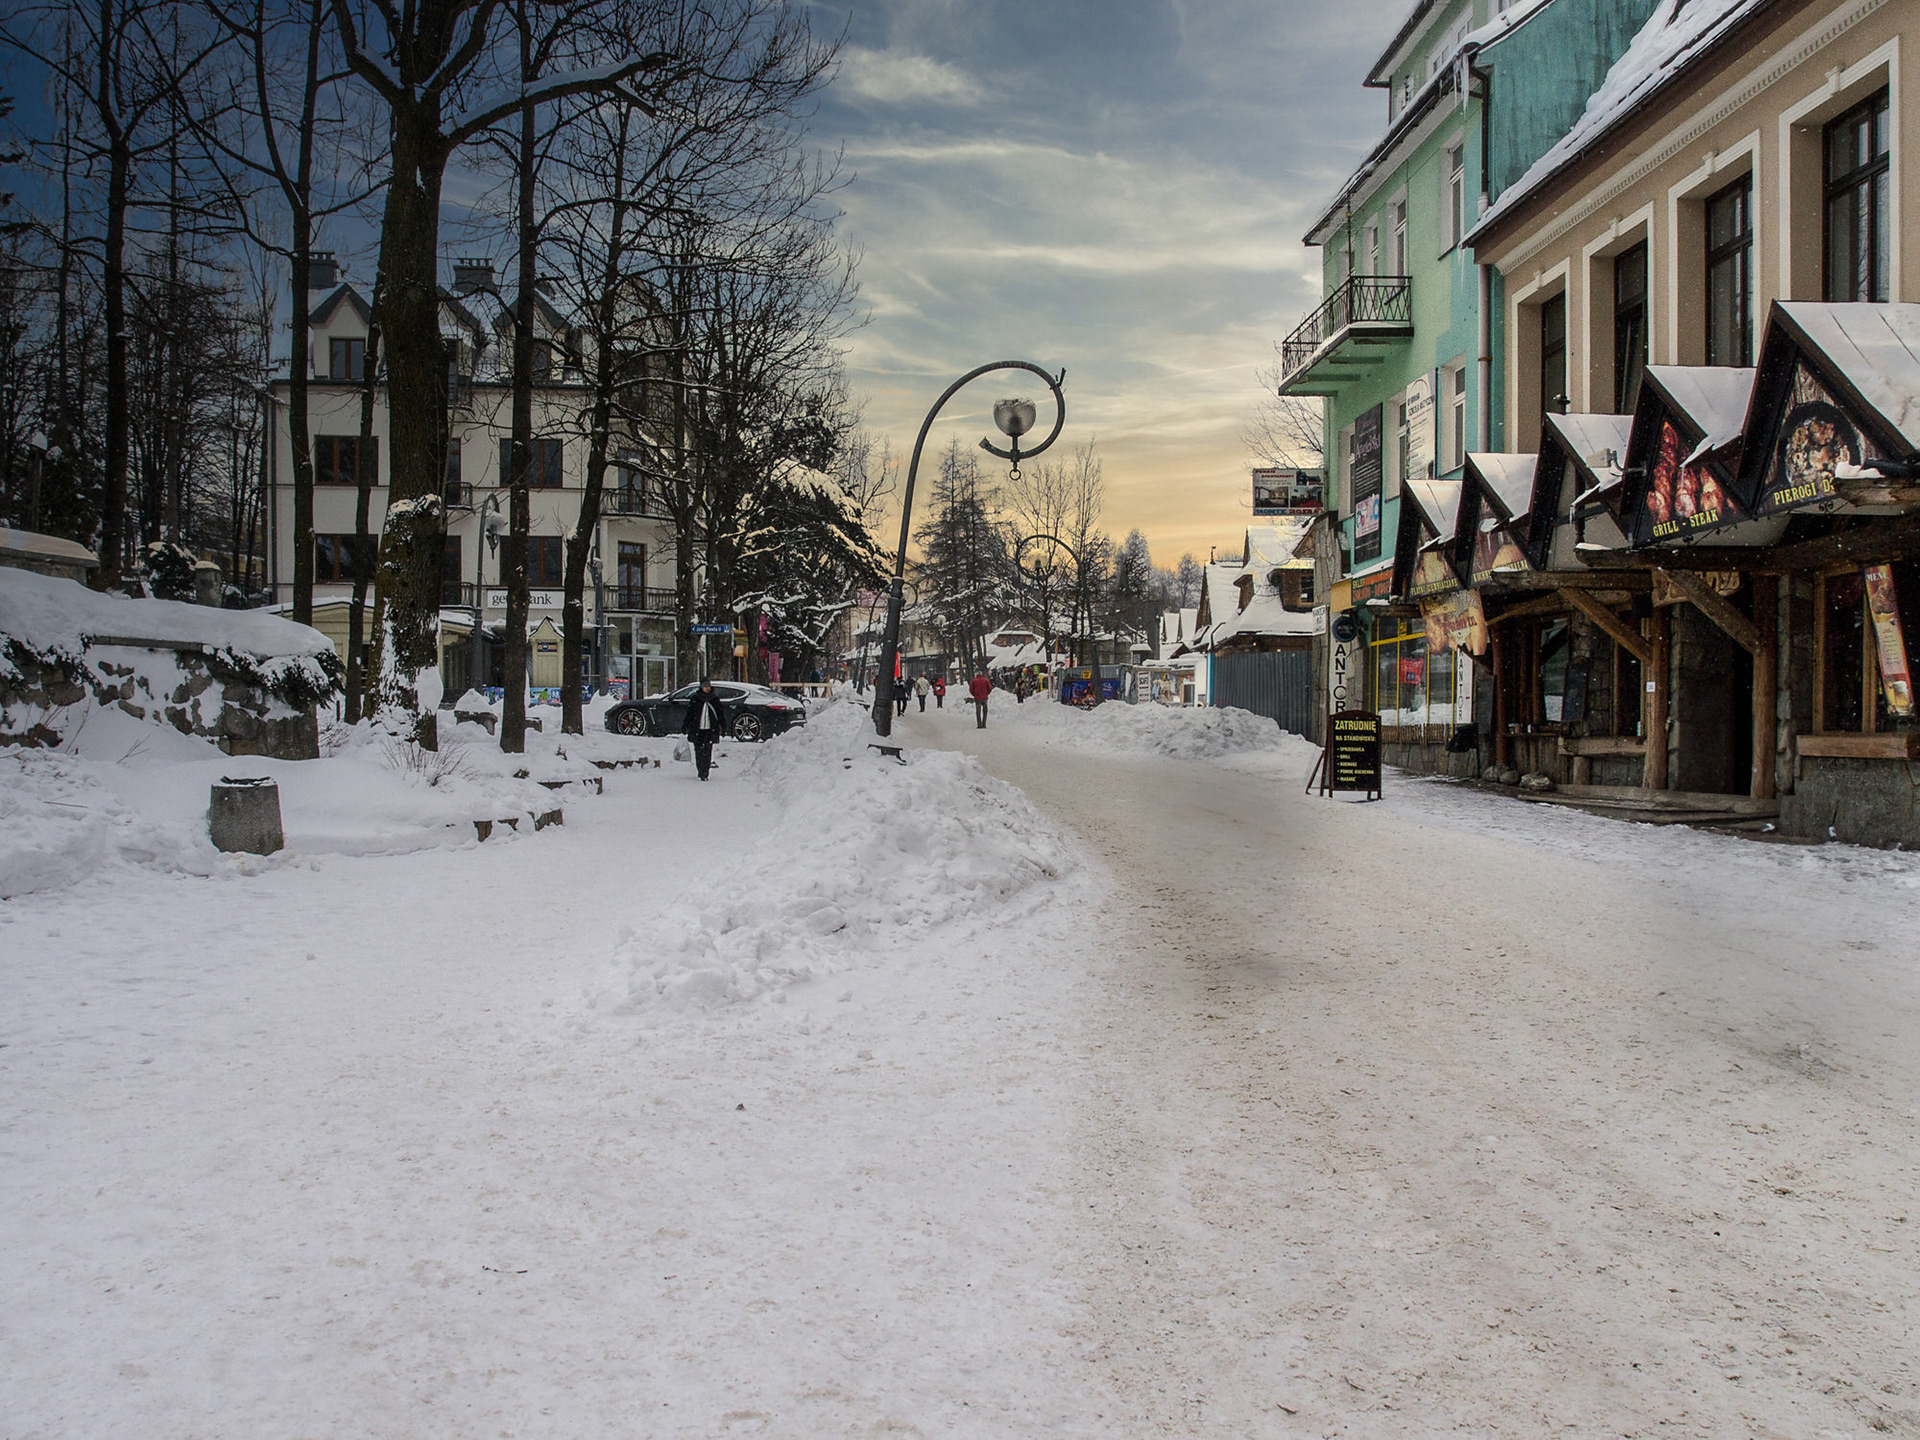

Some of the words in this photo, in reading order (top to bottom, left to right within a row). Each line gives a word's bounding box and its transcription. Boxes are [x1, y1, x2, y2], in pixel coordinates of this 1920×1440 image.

[1774, 482, 1817, 506] PIEROGI
[1653, 519, 1680, 537] GRILL
[1689, 508, 1719, 528] STEAK
[1866, 572, 1889, 581] MENU
[1334, 641, 1346, 713] ANTOR
[1334, 719, 1377, 733] ZATRUDNIĘ
